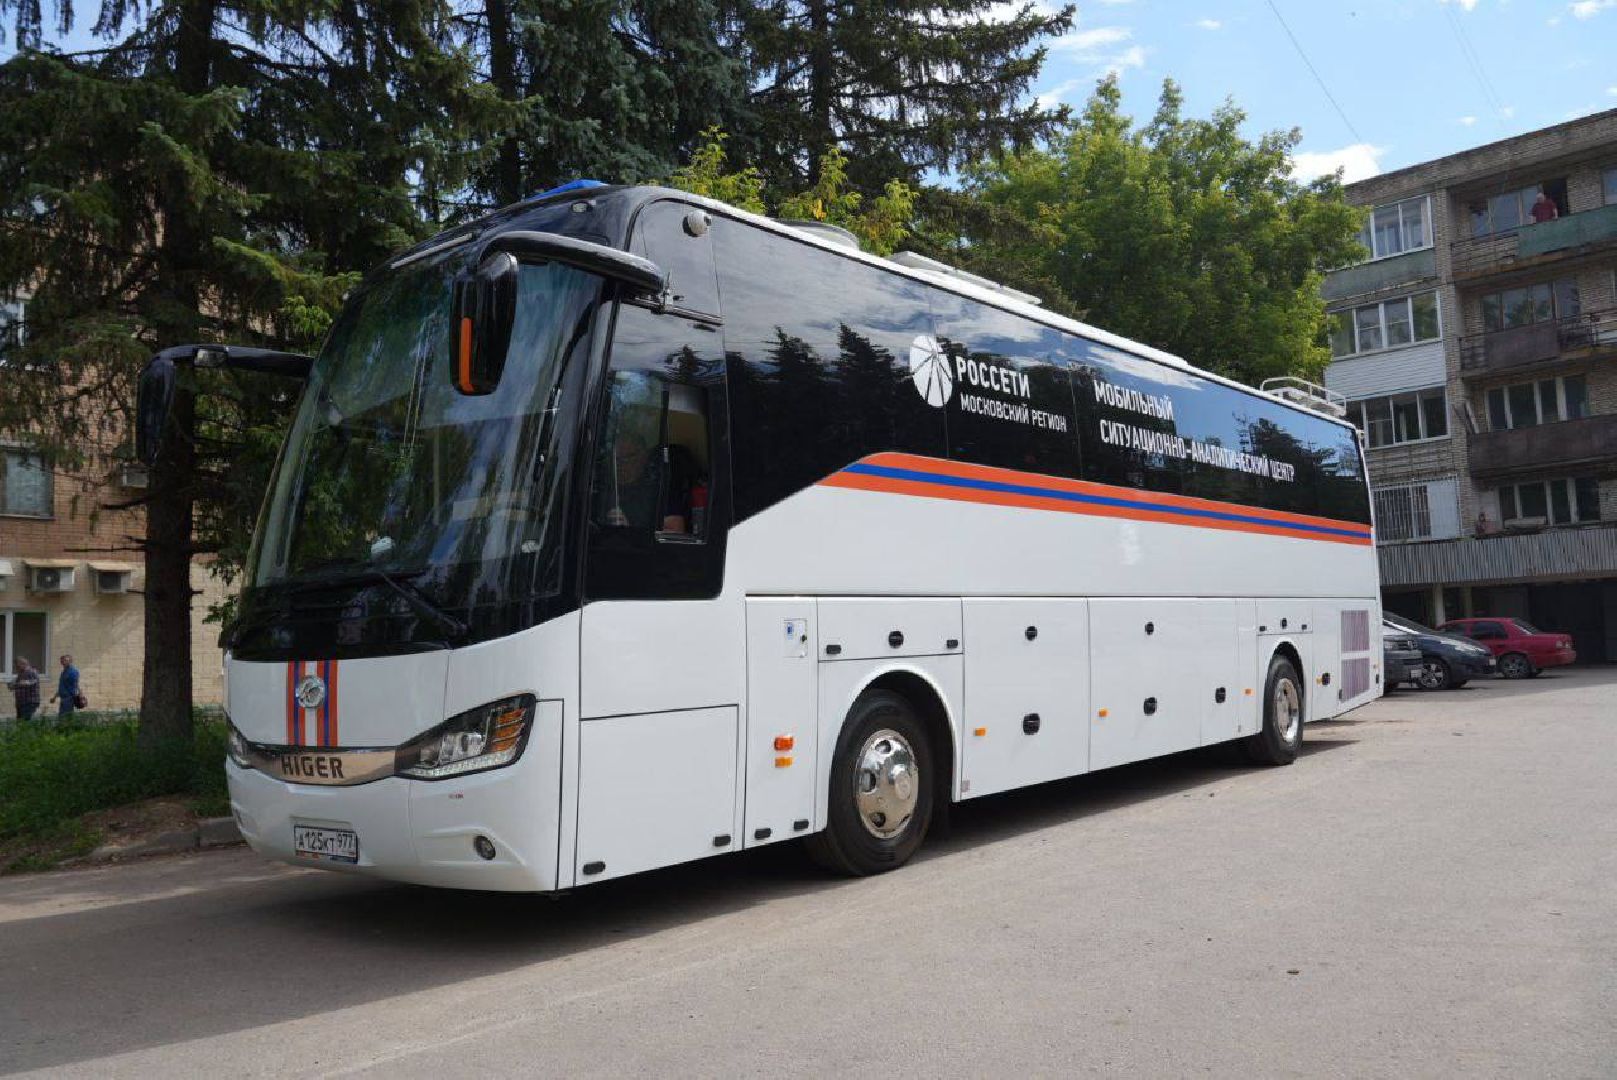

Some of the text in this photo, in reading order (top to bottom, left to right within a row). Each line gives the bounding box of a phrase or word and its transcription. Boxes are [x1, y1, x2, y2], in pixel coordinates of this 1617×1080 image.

[955, 356, 1031, 399] РОССЕТИ
[960, 392, 1068, 433] МОСКОВСКИЙ РЕГИОН
[1094, 379, 1174, 420] МОБИЛЬНЫЙ
[1100, 419, 1295, 483] СИТУАЦИОННО-АНАЛИТИЧЕСКИЙ ЦЕНТР
[281, 755, 344, 779] HIGER
